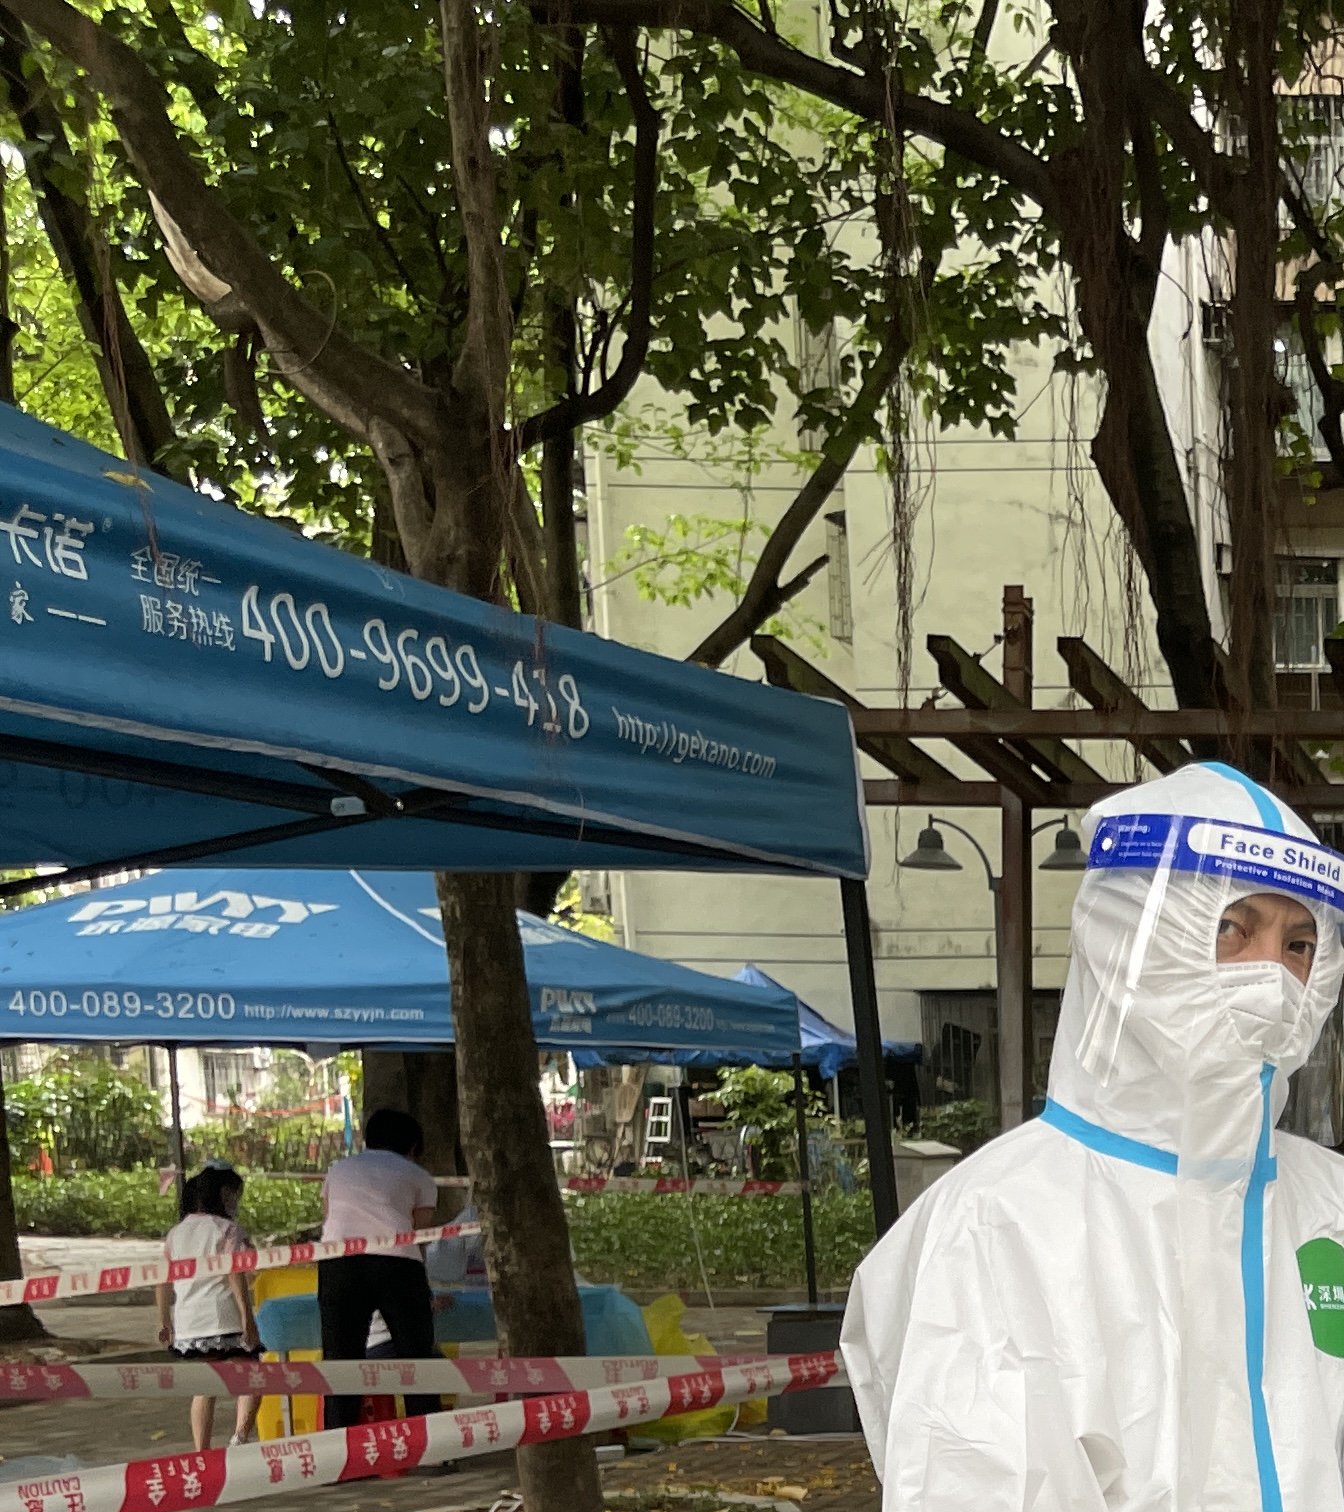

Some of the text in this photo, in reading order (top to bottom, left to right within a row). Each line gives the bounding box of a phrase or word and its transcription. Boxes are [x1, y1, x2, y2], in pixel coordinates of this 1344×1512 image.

[130, 546, 222, 597] 全国统一
[139, 594, 236, 651] 服务热线
[1220, 833, 1341, 882] Face Shield
[1215, 859, 1268, 877] Protective
[1273, 870, 1313, 890] Isolation
[8, 990, 236, 1020] 400-089-3200
[151, 1456, 207, 1480] SAFE
[17, 1476, 81, 1501] CAUTION
[145, 1471, 202, 1506] 安全
